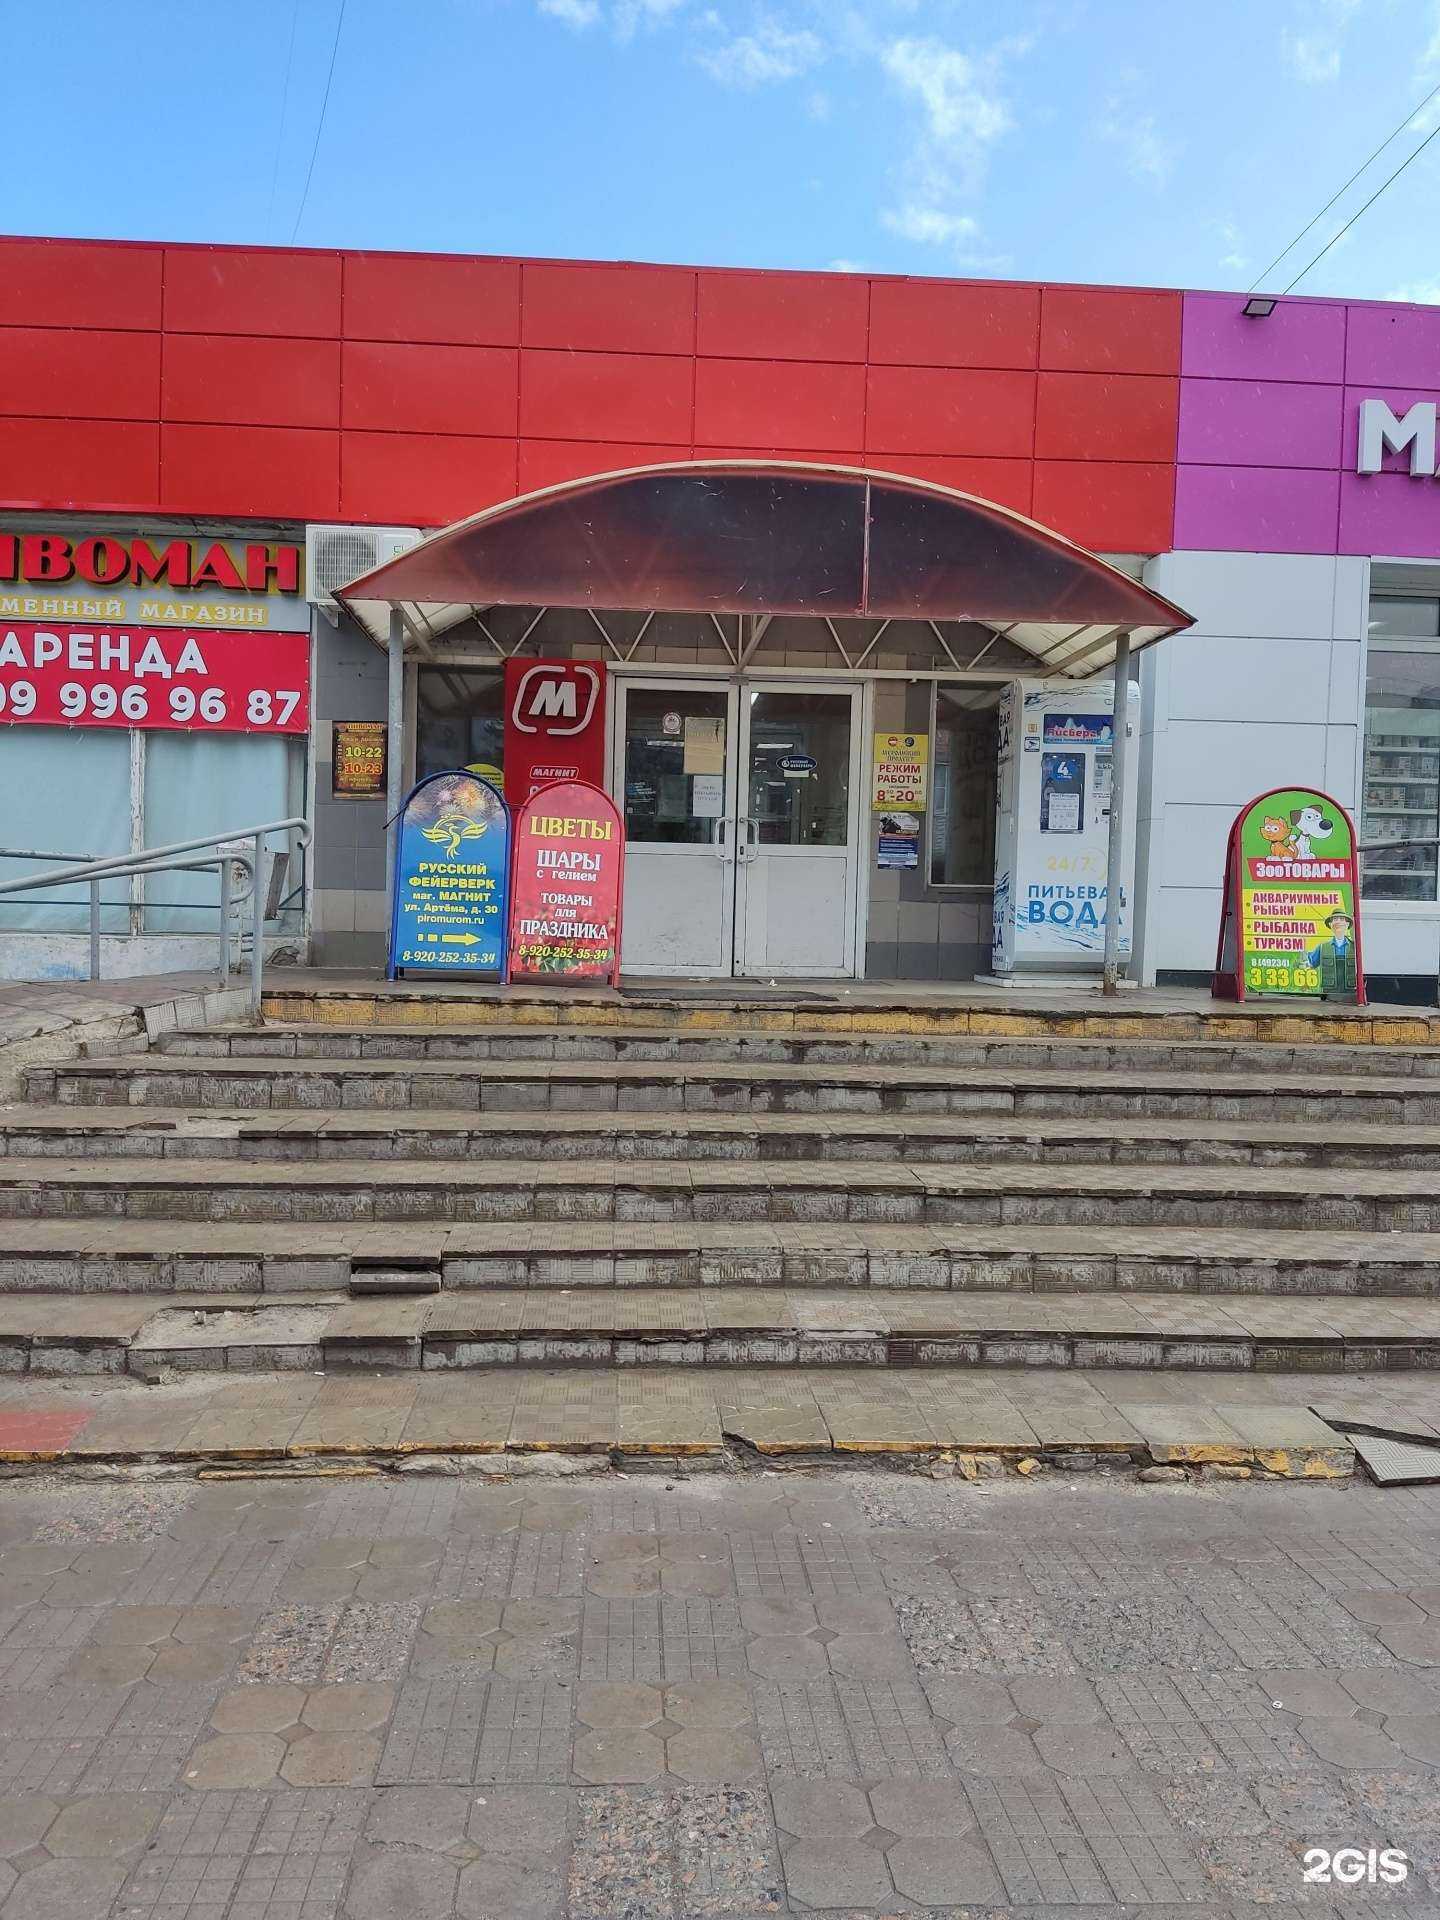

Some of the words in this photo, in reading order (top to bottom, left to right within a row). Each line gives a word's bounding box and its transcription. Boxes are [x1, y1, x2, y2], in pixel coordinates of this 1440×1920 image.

[1, 598, 122, 618] МЕННЫЙ
[140, 603, 265, 624] МАГАЗИН
[0, 631, 208, 679] АРЕНДА
[59, 682, 149, 720] 996
[169, 686, 227, 723] 96
[246, 689, 300, 725] 87
[345, 746, 382, 758] 10-22
[533, 767, 577, 778] МАГНИТ
[879, 764, 921, 774] РЕЖИМ
[877, 775, 922, 784] РАБОТЫ
[530, 816, 612, 840] ЦВЕТЫ
[536, 849, 601, 870] ШАРЫ
[418, 861, 487, 875] РУССКИЙ
[536, 869, 544, 878] с
[551, 870, 597, 881] гелием
[1256, 862, 1345, 878] ЗооТОВАРЫ
[408, 875, 496, 890] ФЕЙЕРВЕРК
[412, 892, 436, 900] маг.
[439, 891, 491, 902] МАГНИТ
[541, 892, 592, 906] ТОВАРЫ
[1028, 885, 1124, 899] ПИТЬЕВА
[1252, 892, 1339, 905] АКВАРИУМНЫЕ
[404, 903, 421, 912] ул.
[423, 902, 468, 914] Артёма,
[484, 905, 498, 914] 30
[555, 908, 577, 918] для
[1253, 904, 1295, 916] РЫБКИ
[416, 914, 485, 925] piromurom.ru
[519, 919, 609, 940] ПРАЗДНИКА
[1253, 921, 1316, 934] РЫБАЛКА
[1254, 937, 1304, 950] ТУРИЗМ
[402, 950, 496, 964] 8-920-252-35-34
[518, 944, 608, 960] 8-920-252-35-34
[1250, 968, 1262, 986] 3
[1266, 968, 1290, 987] 33
[1293, 969, 1318, 987] 66
